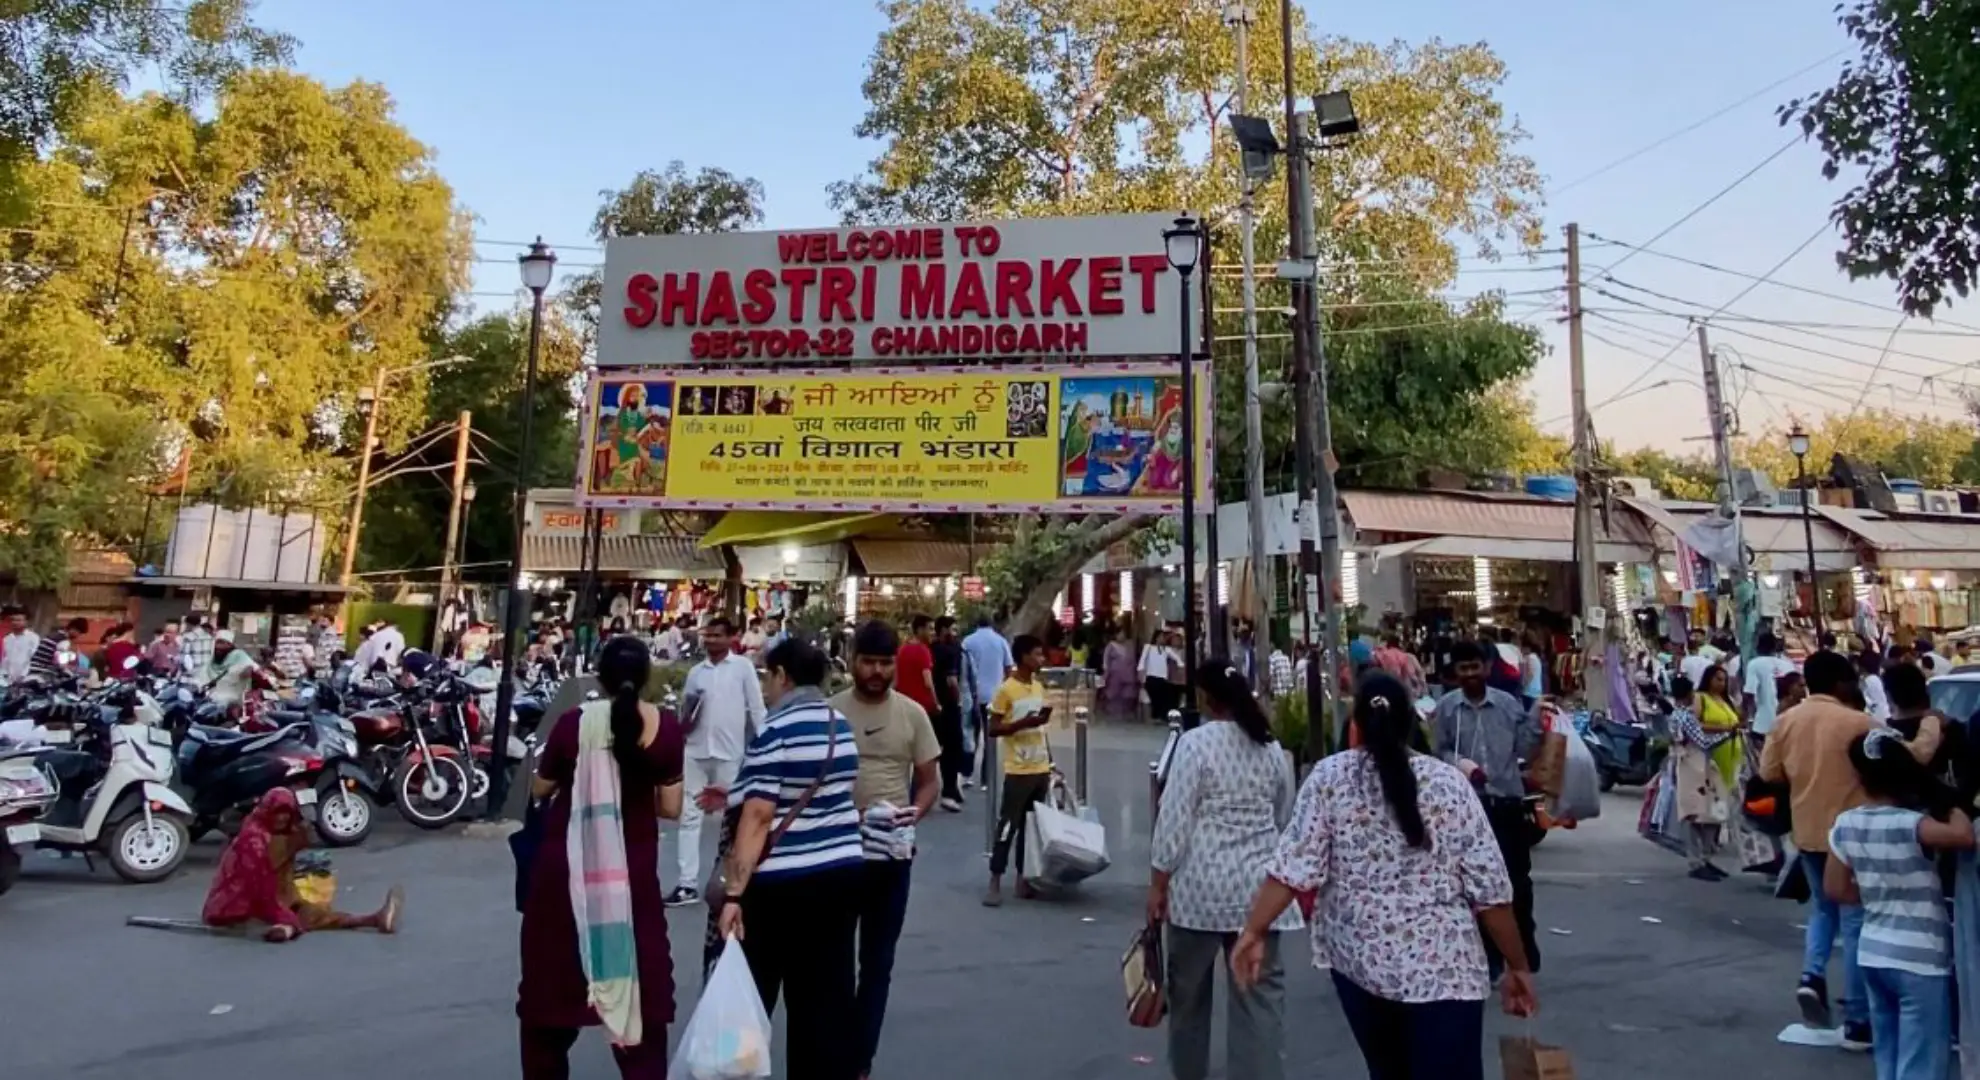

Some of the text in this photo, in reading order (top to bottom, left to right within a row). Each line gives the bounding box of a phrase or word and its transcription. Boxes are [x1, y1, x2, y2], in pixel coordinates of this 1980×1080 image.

[777, 226, 1000, 263] WELCOME TO
[623, 254, 1168, 328] SHASTRI MARKET
[690, 323, 1088, 359] SECTOR-22 CHANDIGARH
[802, 380, 1000, 412] ਜੀ ਆਇਆਂ ਨੂੰ
[792, 416, 824, 433] जय
[915, 410, 944, 432] पीर
[950, 410, 977, 432] जी
[709, 434, 1017, 460] 45वां विशाल भंडारा
